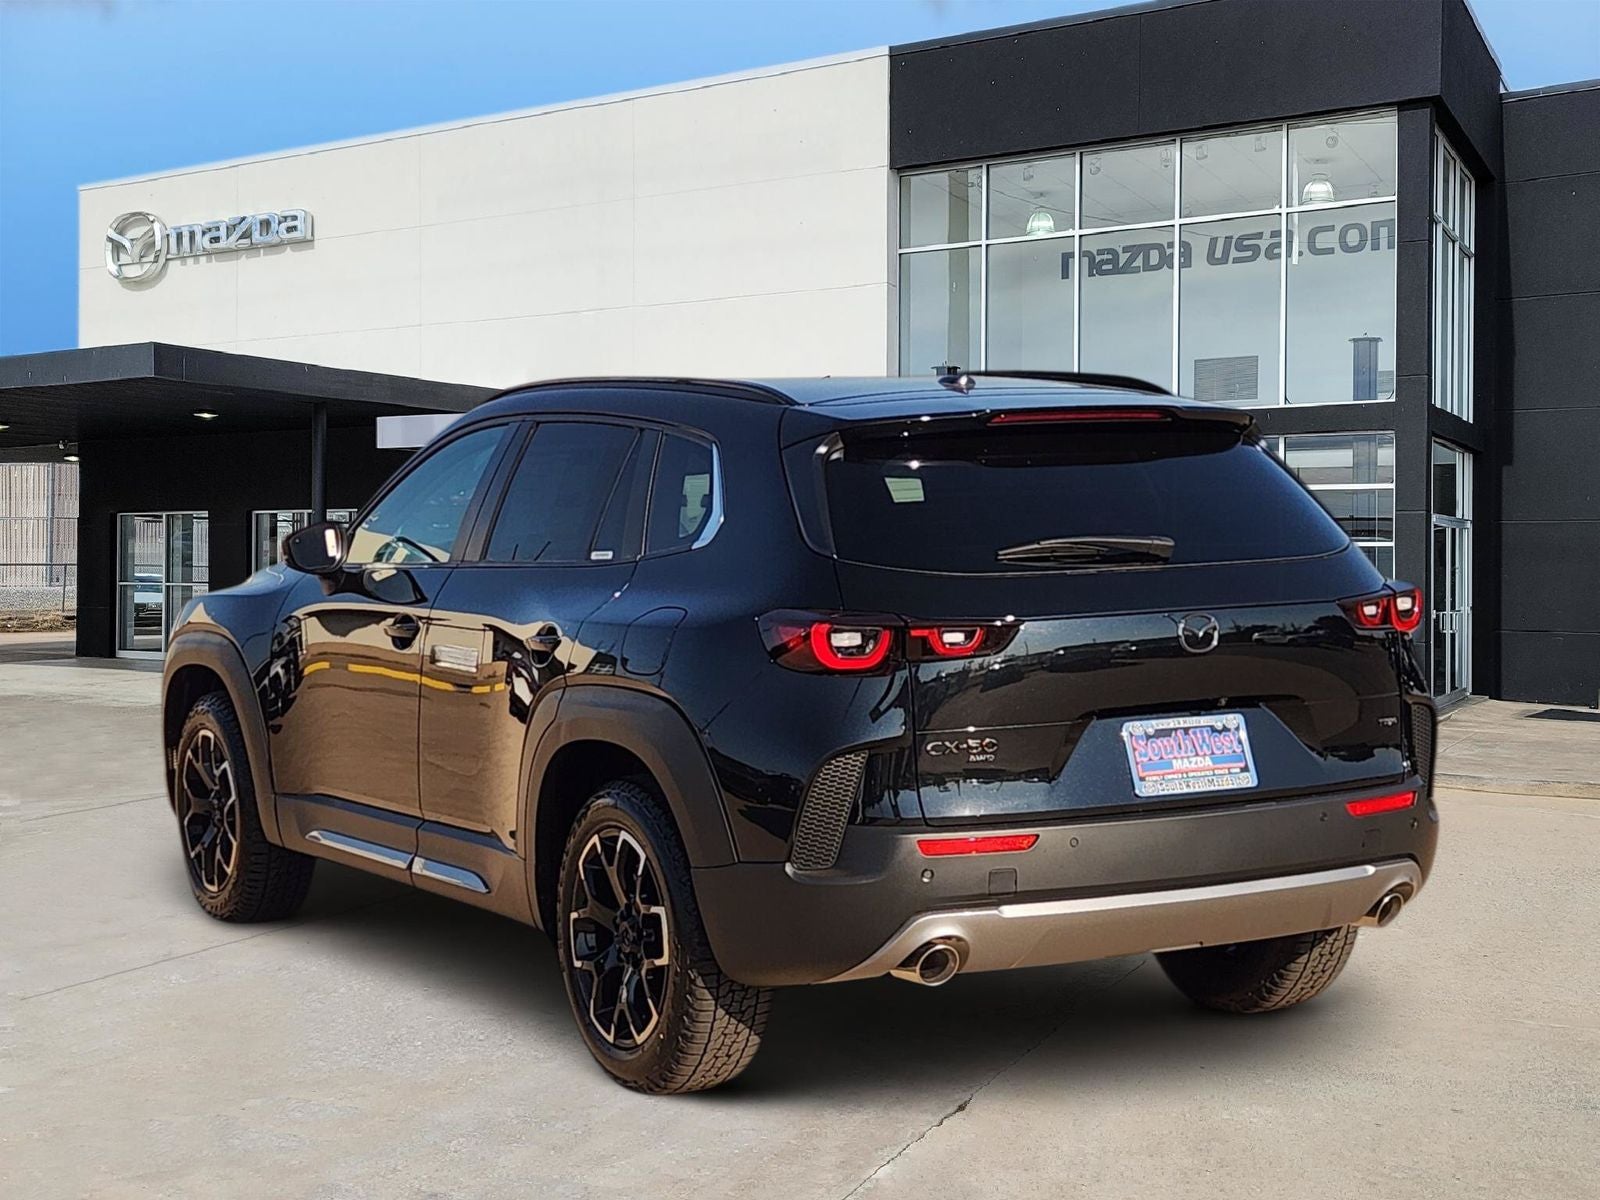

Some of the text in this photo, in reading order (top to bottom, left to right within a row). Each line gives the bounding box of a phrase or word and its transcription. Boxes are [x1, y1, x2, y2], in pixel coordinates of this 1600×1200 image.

[166, 208, 314, 257] mazda
[1061, 238, 1193, 280] mazda
[926, 738, 998, 756] CX-50
[968, 754, 995, 762] AWD
[1172, 756, 1214, 770] MAZDA
